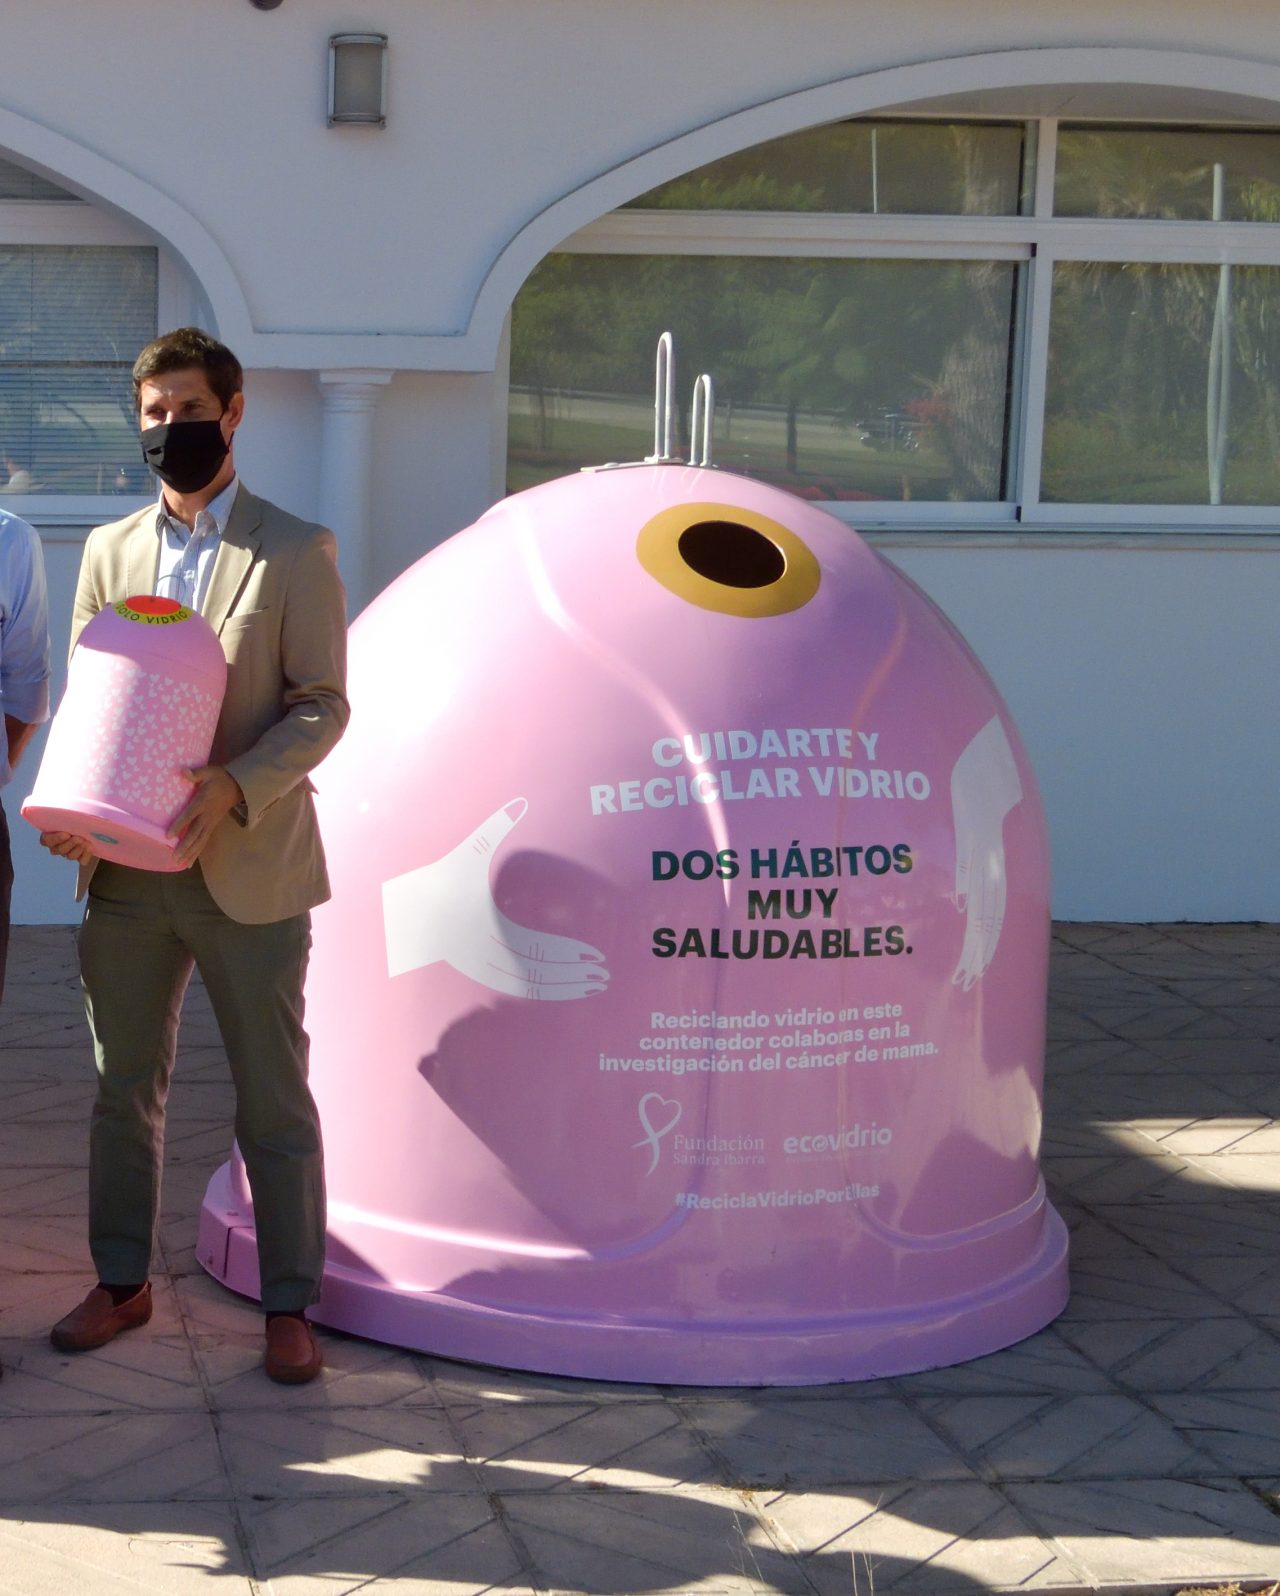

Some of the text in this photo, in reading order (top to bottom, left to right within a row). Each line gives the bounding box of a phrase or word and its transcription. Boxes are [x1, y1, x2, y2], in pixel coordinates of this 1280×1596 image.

[147, 610, 188, 625] VIDRIO
[651, 727, 880, 769] CUIDARTE Y
[589, 766, 931, 816] RECICLAR VIDRIO
[651, 840, 914, 881] DOS HÁBITOS
[747, 888, 839, 920] MUY
[651, 925, 914, 960] SALUDABLES.
[651, 1002, 903, 1029] Reciclando vidrio en este
[639, 1020, 911, 1051] contenedor colaboras en la
[599, 1042, 939, 1075] investigación del cáncer de mama.
[673, 1133, 765, 1151] Fundación
[783, 1122, 893, 1154] ecovidrio
